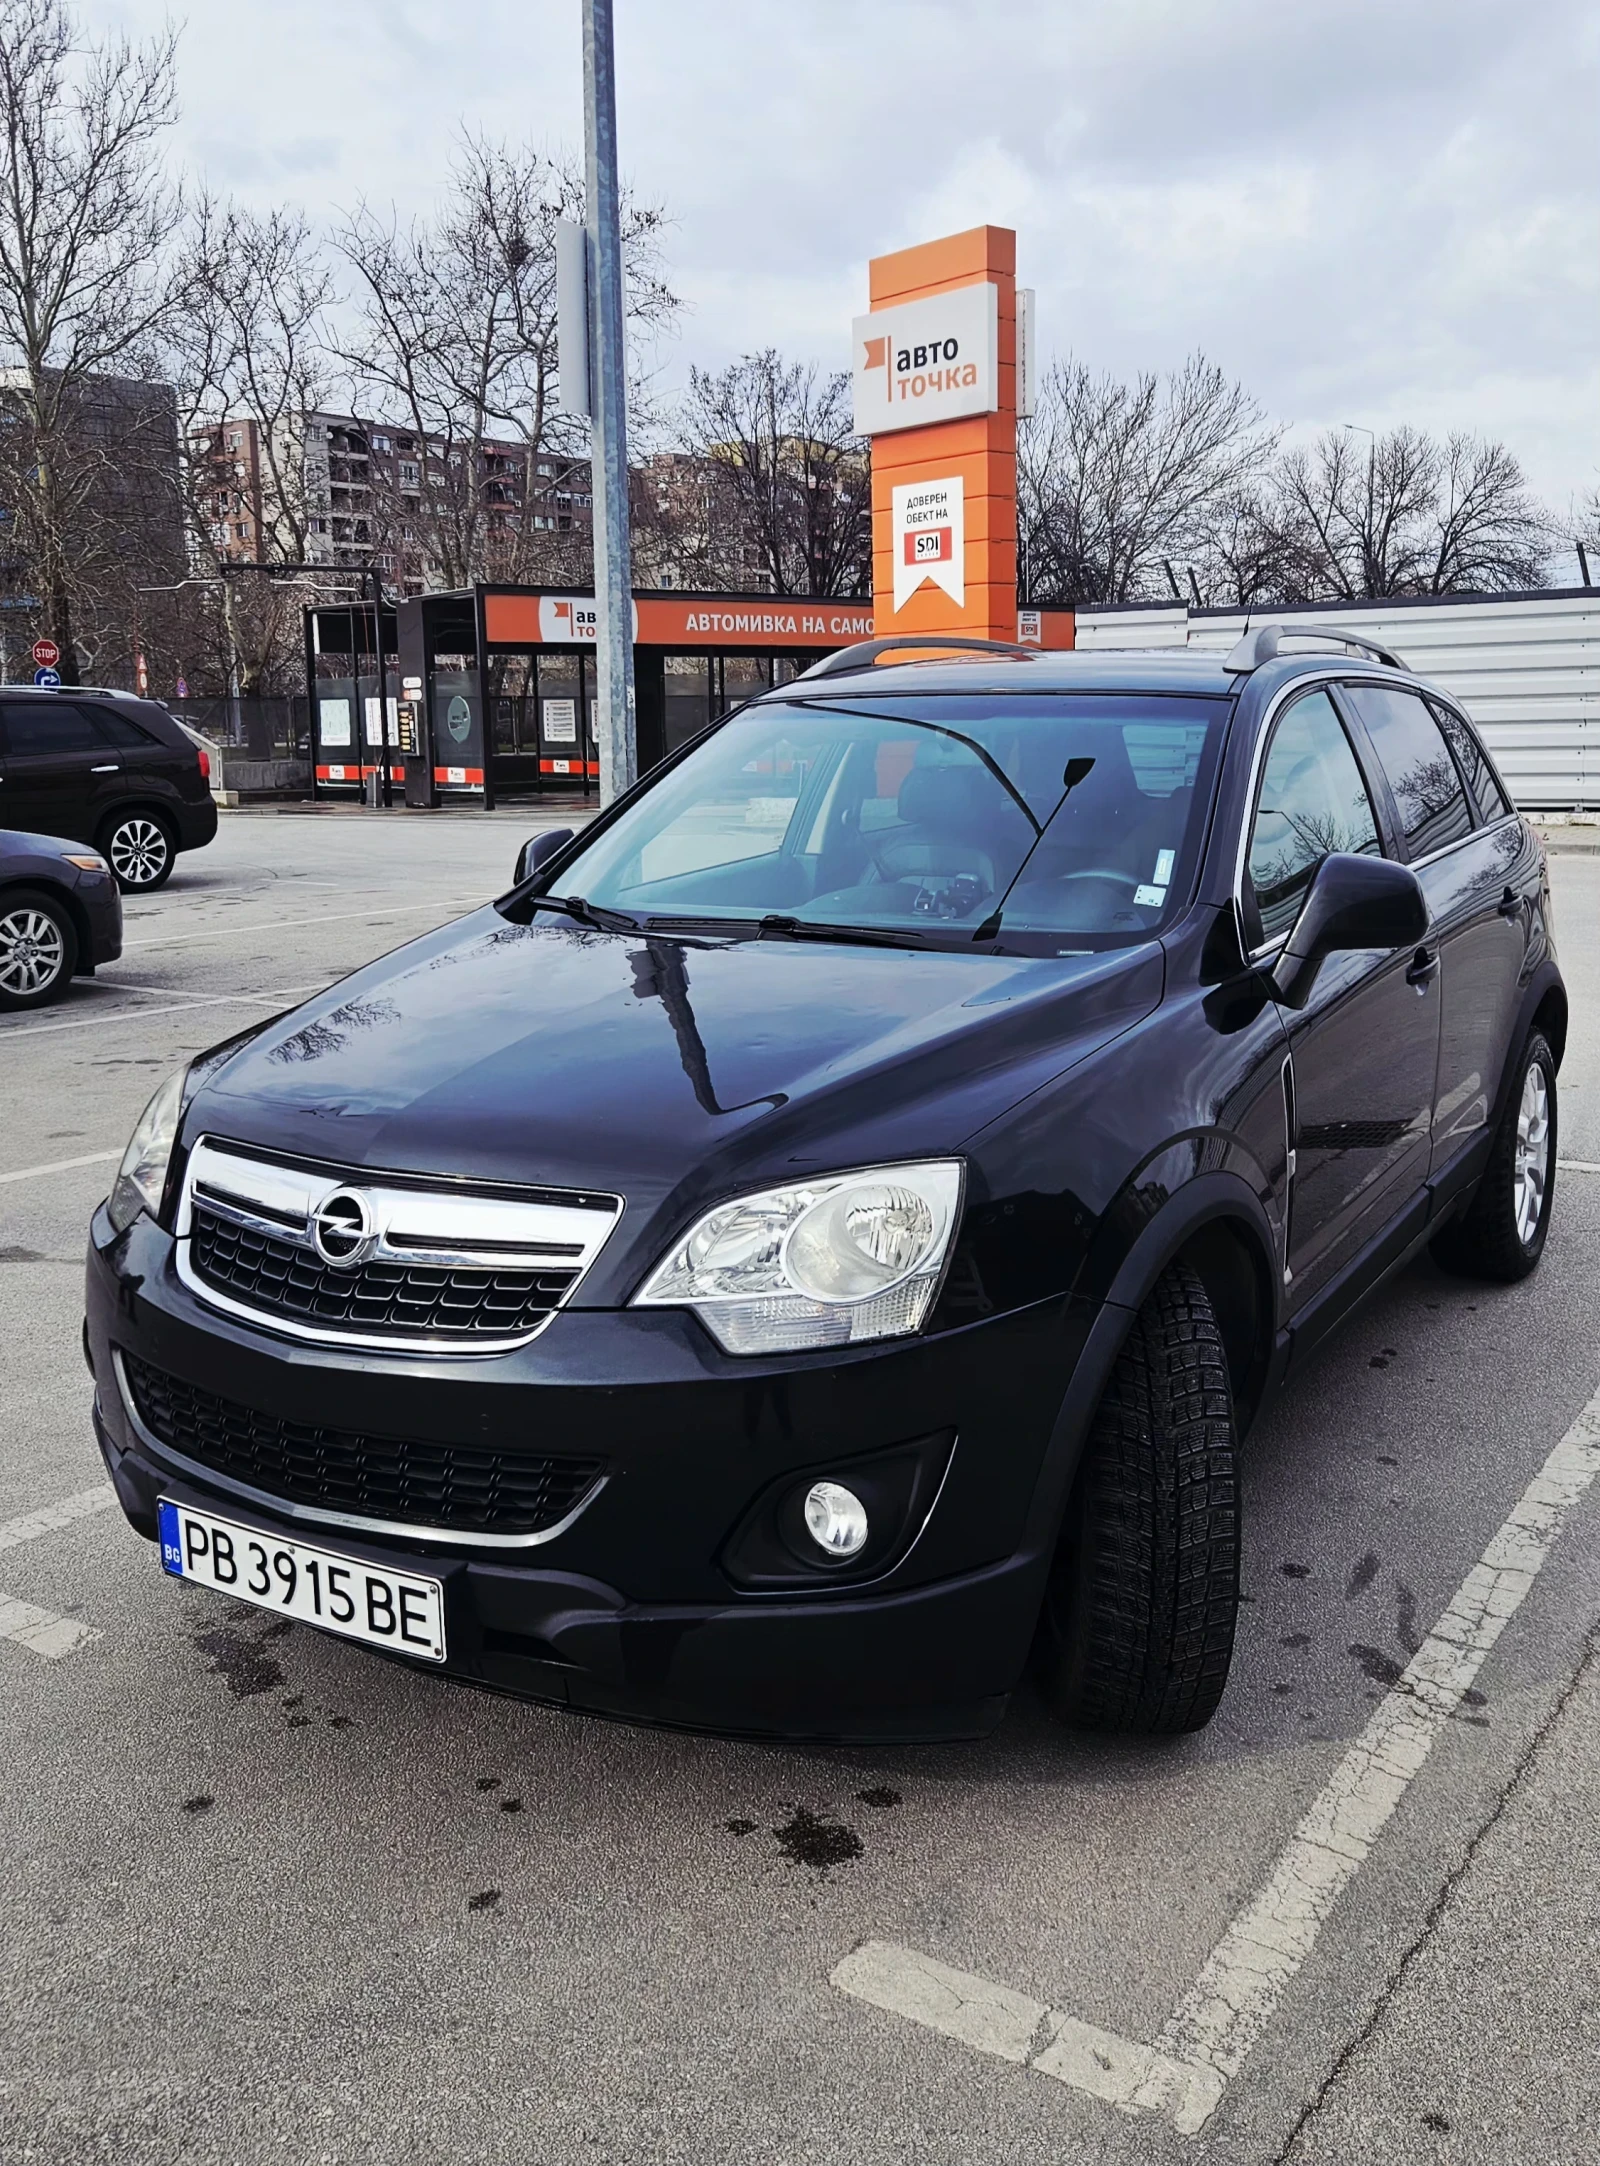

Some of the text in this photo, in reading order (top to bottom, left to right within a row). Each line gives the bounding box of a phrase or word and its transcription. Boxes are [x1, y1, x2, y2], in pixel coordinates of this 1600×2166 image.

[897, 338, 958, 372] авто
[897, 363, 977, 400] точка
[907, 492, 947, 510] ДОВЕРЕН
[906, 508, 948, 524] ОБЕКТ НА
[917, 536, 938, 553] SDI
[576, 611, 597, 624] ав
[686, 614, 797, 633] АВТОМИВКА
[802, 617, 826, 634] НА
[36, 648, 56, 659] STOP
[164, 1544, 181, 1563] BG
[185, 1518, 432, 1648] PB 3915 BE
